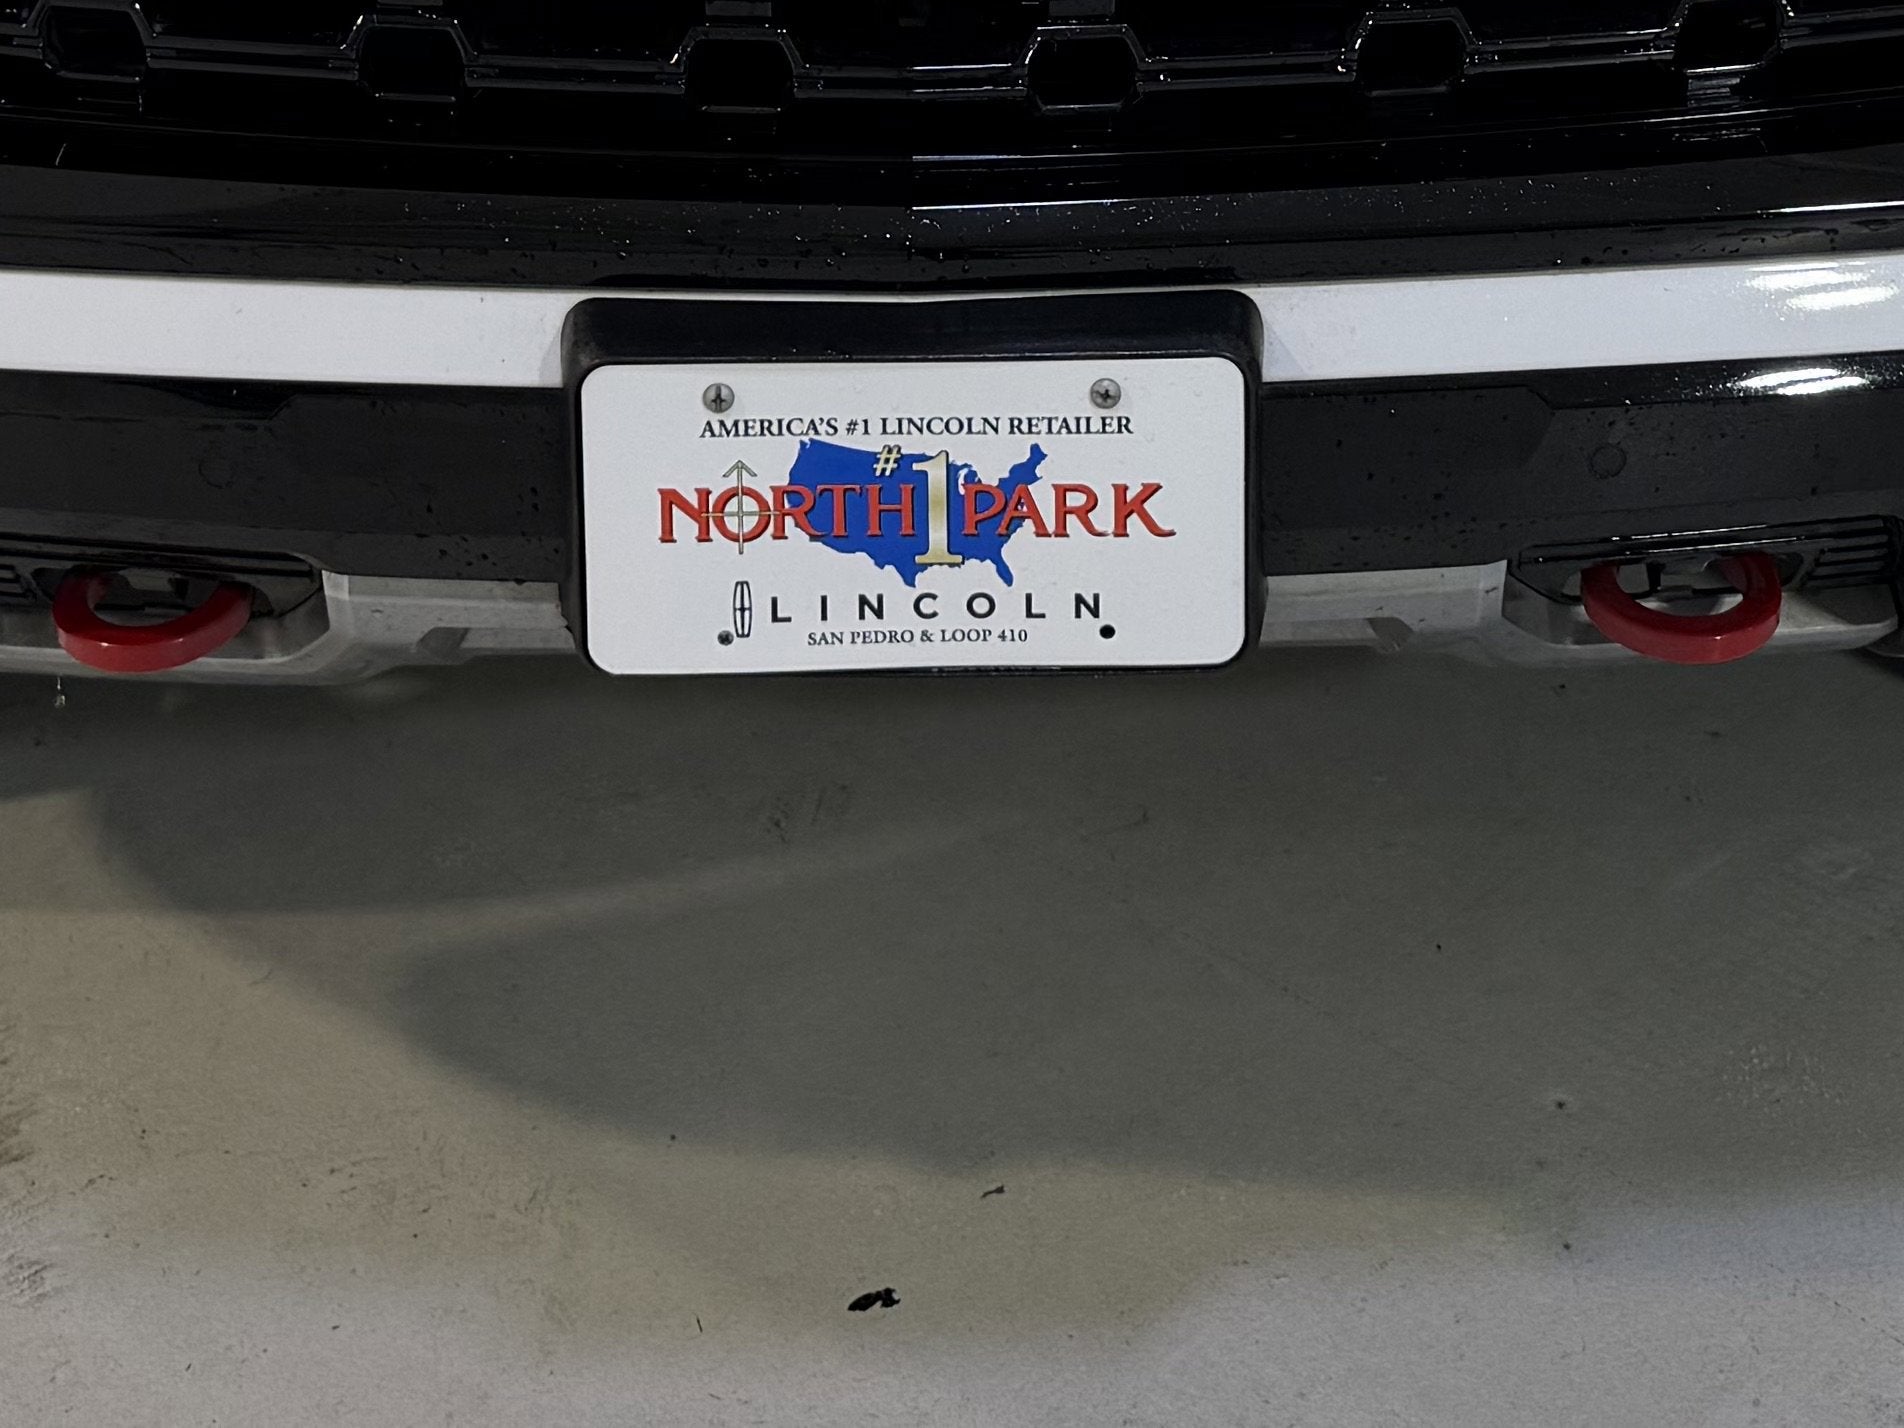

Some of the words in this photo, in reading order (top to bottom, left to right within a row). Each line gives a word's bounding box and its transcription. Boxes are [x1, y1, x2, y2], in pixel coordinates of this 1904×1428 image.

[698, 417, 839, 439] AMERICA'S
[845, 418, 871, 436] #1
[879, 416, 1001, 436] LINCOLN
[1007, 415, 1135, 436] RETAILER
[657, 482, 916, 544] NORTH
[961, 482, 1177, 538] PARK
[770, 591, 1101, 624] LINCOLN
[807, 631, 845, 646] SAN
[849, 630, 916, 645] PEDRO
[919, 629, 935, 643] &
[940, 629, 994, 643] LOOP
[997, 629, 1029, 643] 410
